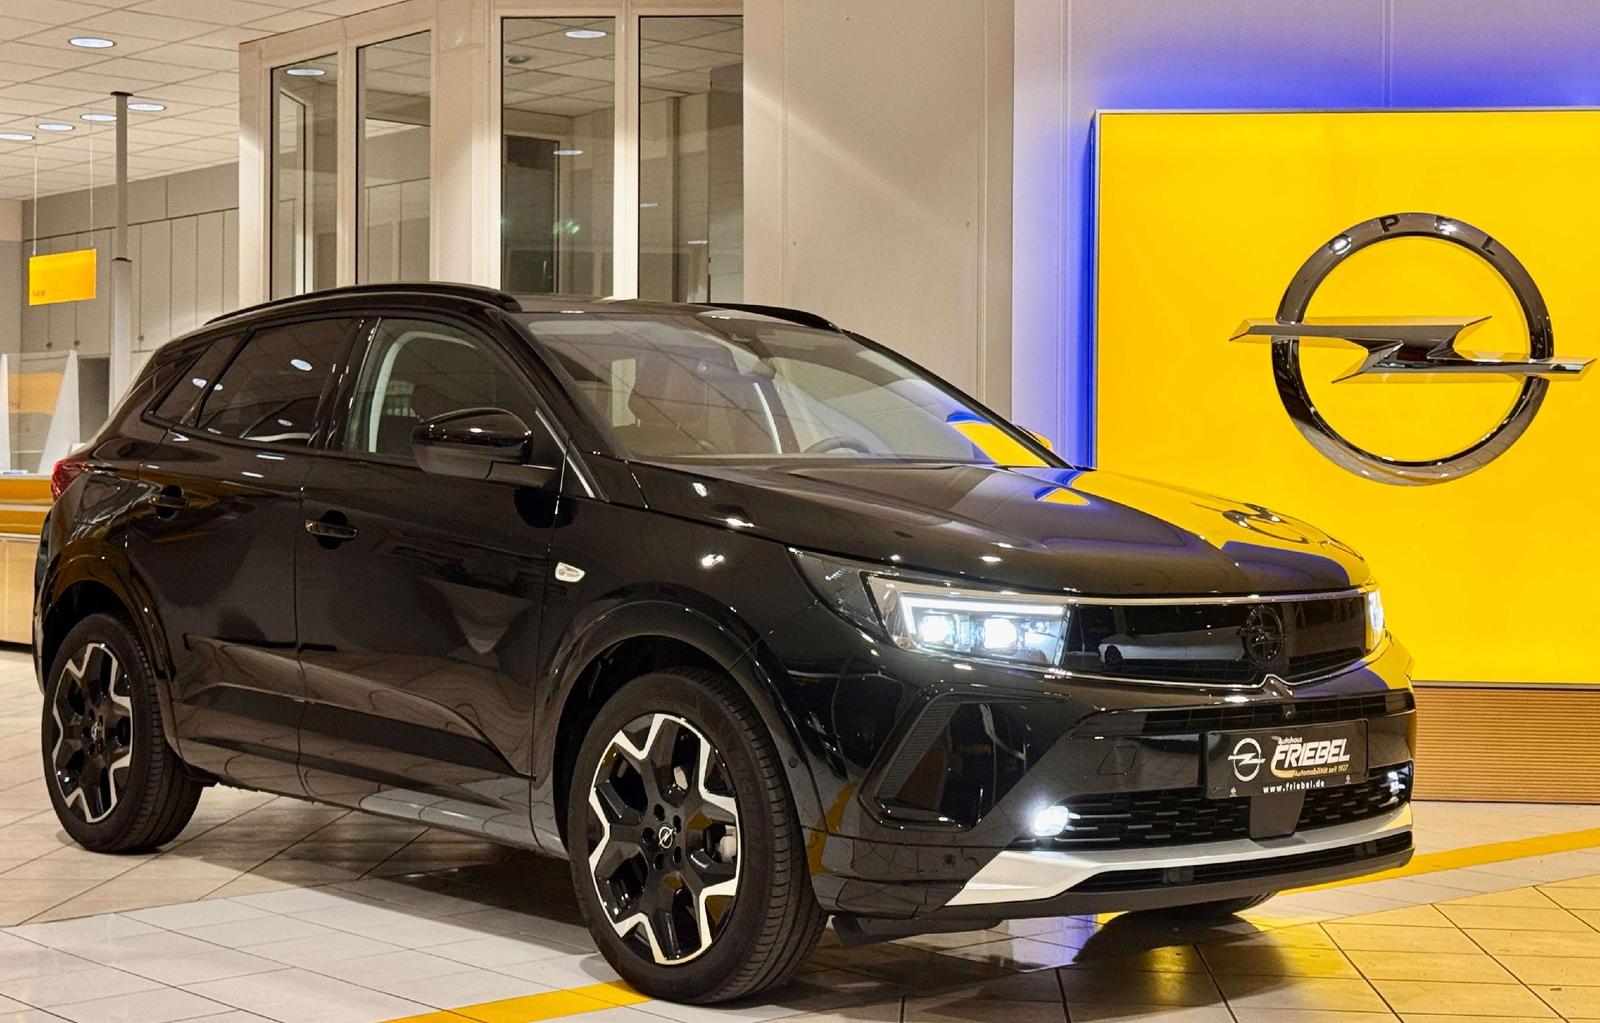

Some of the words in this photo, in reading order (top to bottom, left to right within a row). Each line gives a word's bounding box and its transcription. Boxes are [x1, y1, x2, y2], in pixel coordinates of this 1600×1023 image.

[1329, 213, 1496, 256] OPEL
[1278, 736, 1303, 744] Autohaus
[1271, 738, 1350, 769] FRIEBEL
[1263, 779, 1325, 793] www.friebel.de
